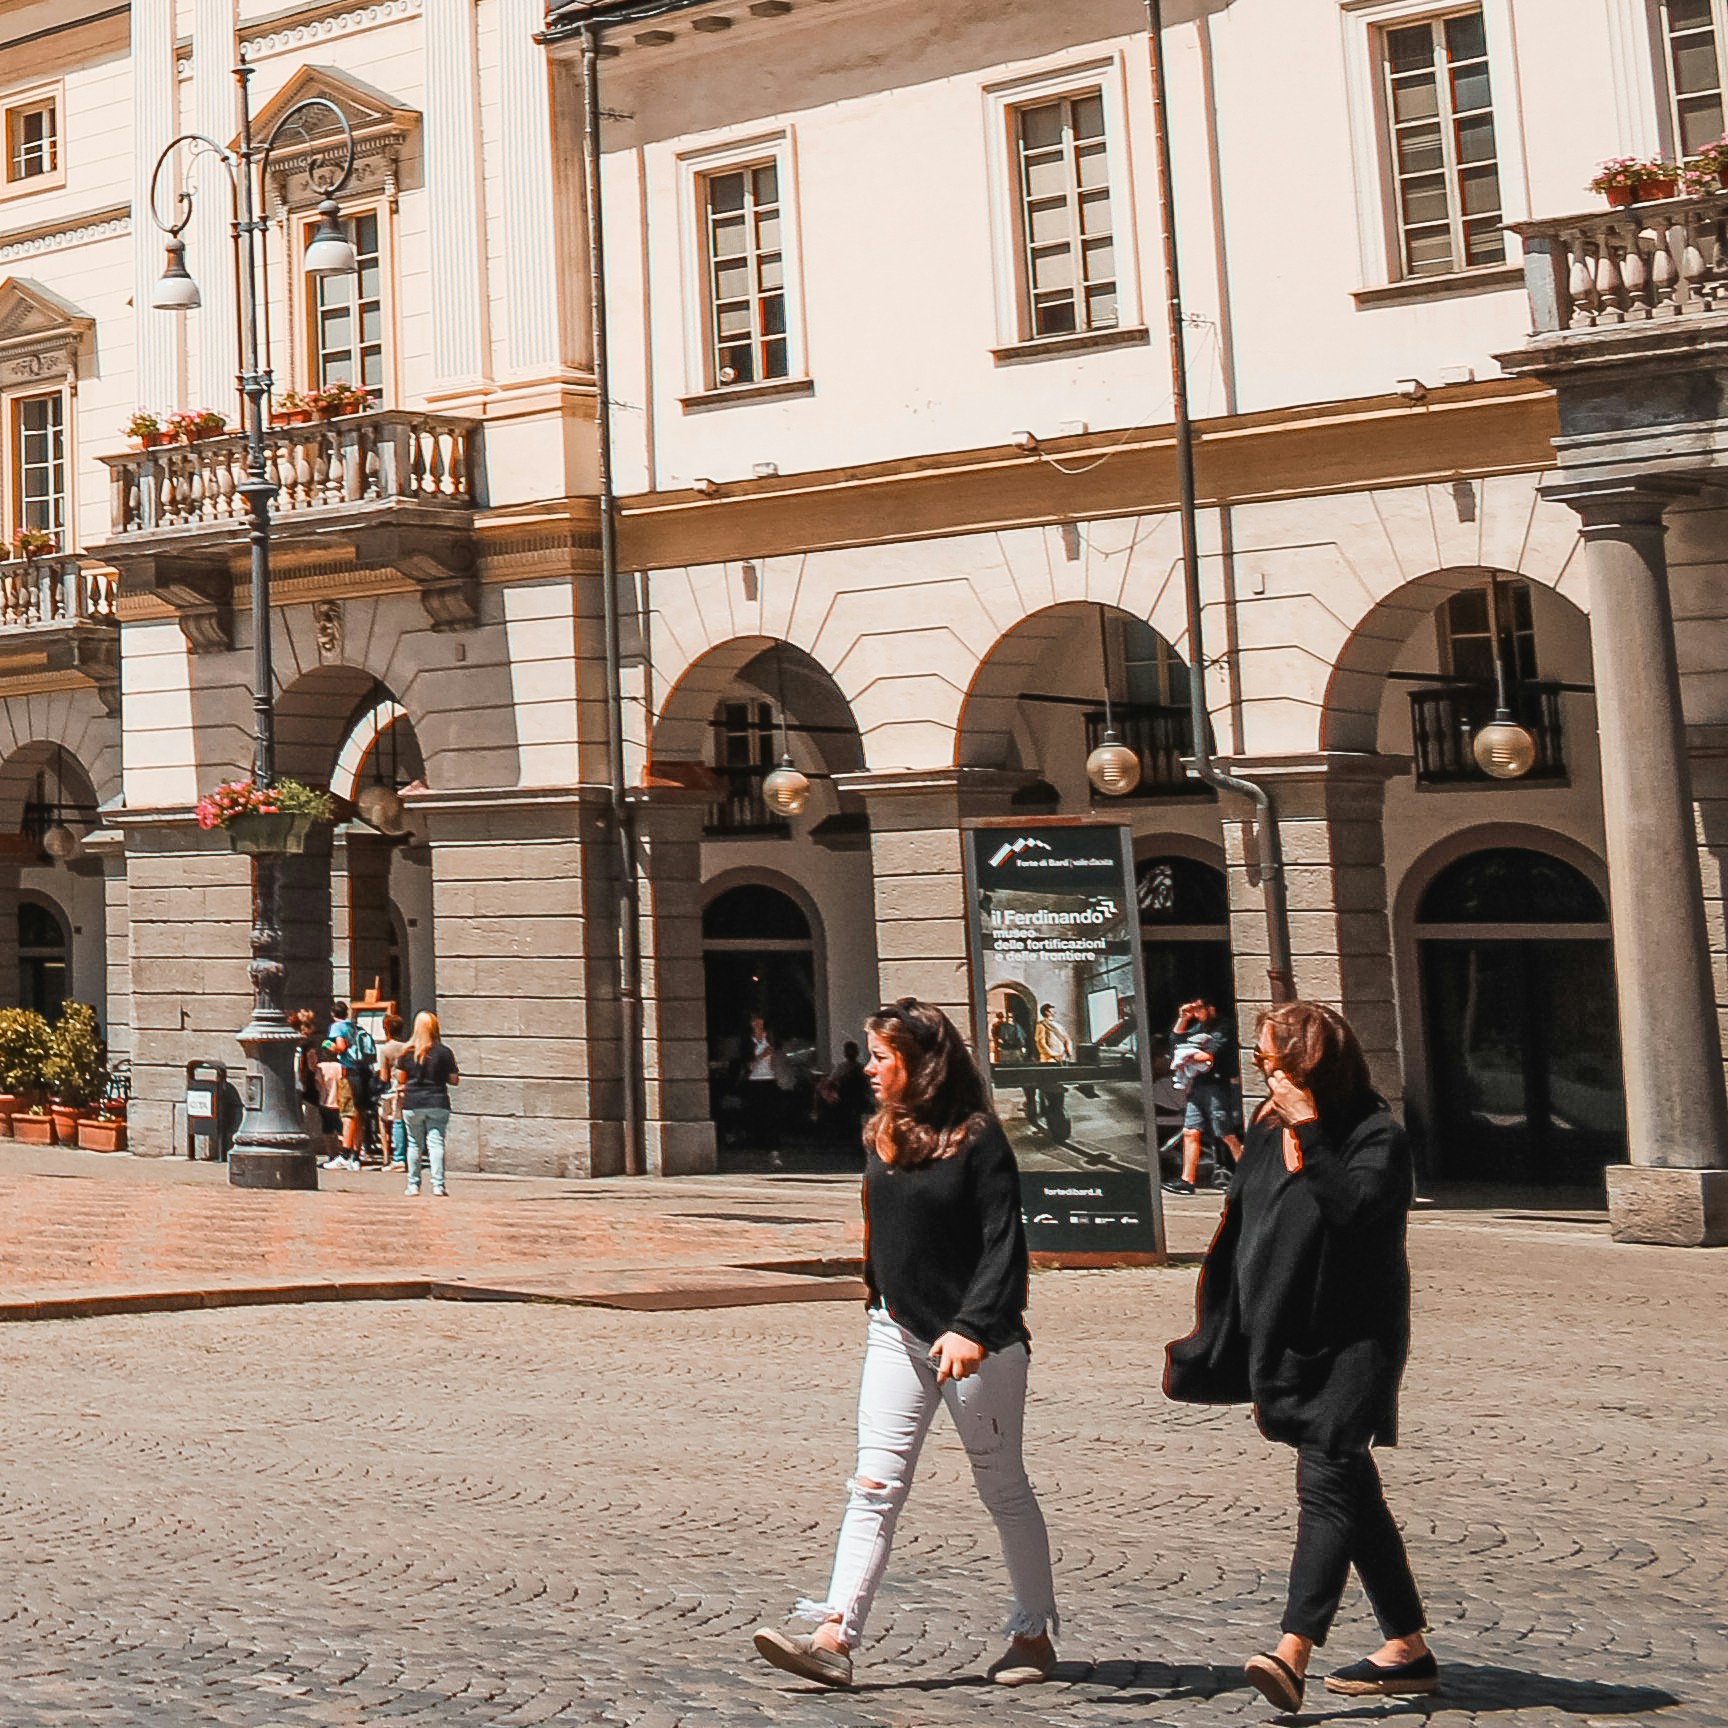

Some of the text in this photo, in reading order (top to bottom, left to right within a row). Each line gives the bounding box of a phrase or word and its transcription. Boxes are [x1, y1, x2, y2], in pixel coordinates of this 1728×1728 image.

[991, 909, 1104, 925] il Ferdinando
[993, 928, 1037, 939] museo
[994, 938, 1107, 950] delle fortificazioni
[995, 950, 1096, 962] e delle frontiere
